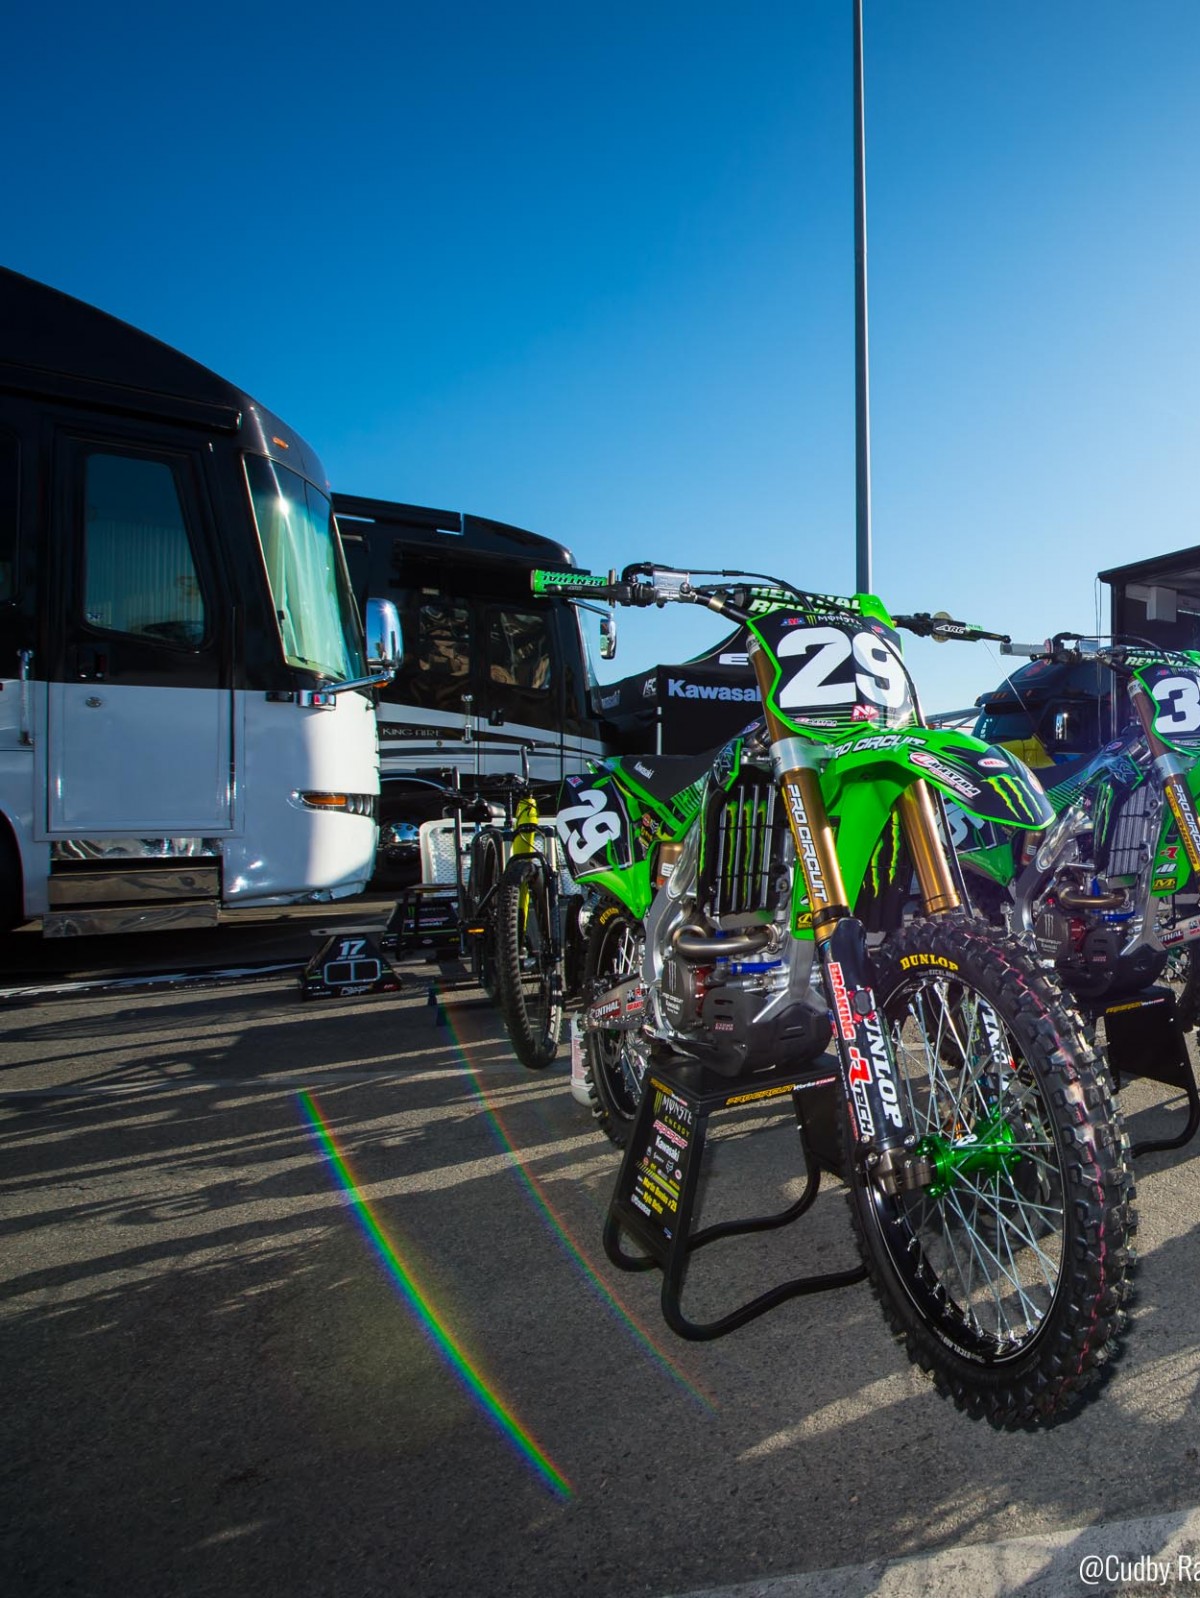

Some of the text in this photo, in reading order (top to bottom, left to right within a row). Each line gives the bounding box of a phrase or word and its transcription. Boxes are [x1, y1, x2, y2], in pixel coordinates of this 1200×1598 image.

[668, 679, 762, 702] Kawasa
[777, 626, 906, 709] 29
[382, 728, 413, 737] KING
[1173, 783, 1191, 811] PRO
[557, 789, 621, 865] 29
[787, 783, 829, 904] PRO CIRCUIT
[340, 939, 366, 956] 17
[900, 953, 959, 972] DUNLOP
[828, 962, 857, 1040] BRAKING
[858, 990, 903, 1128] UNLOP
